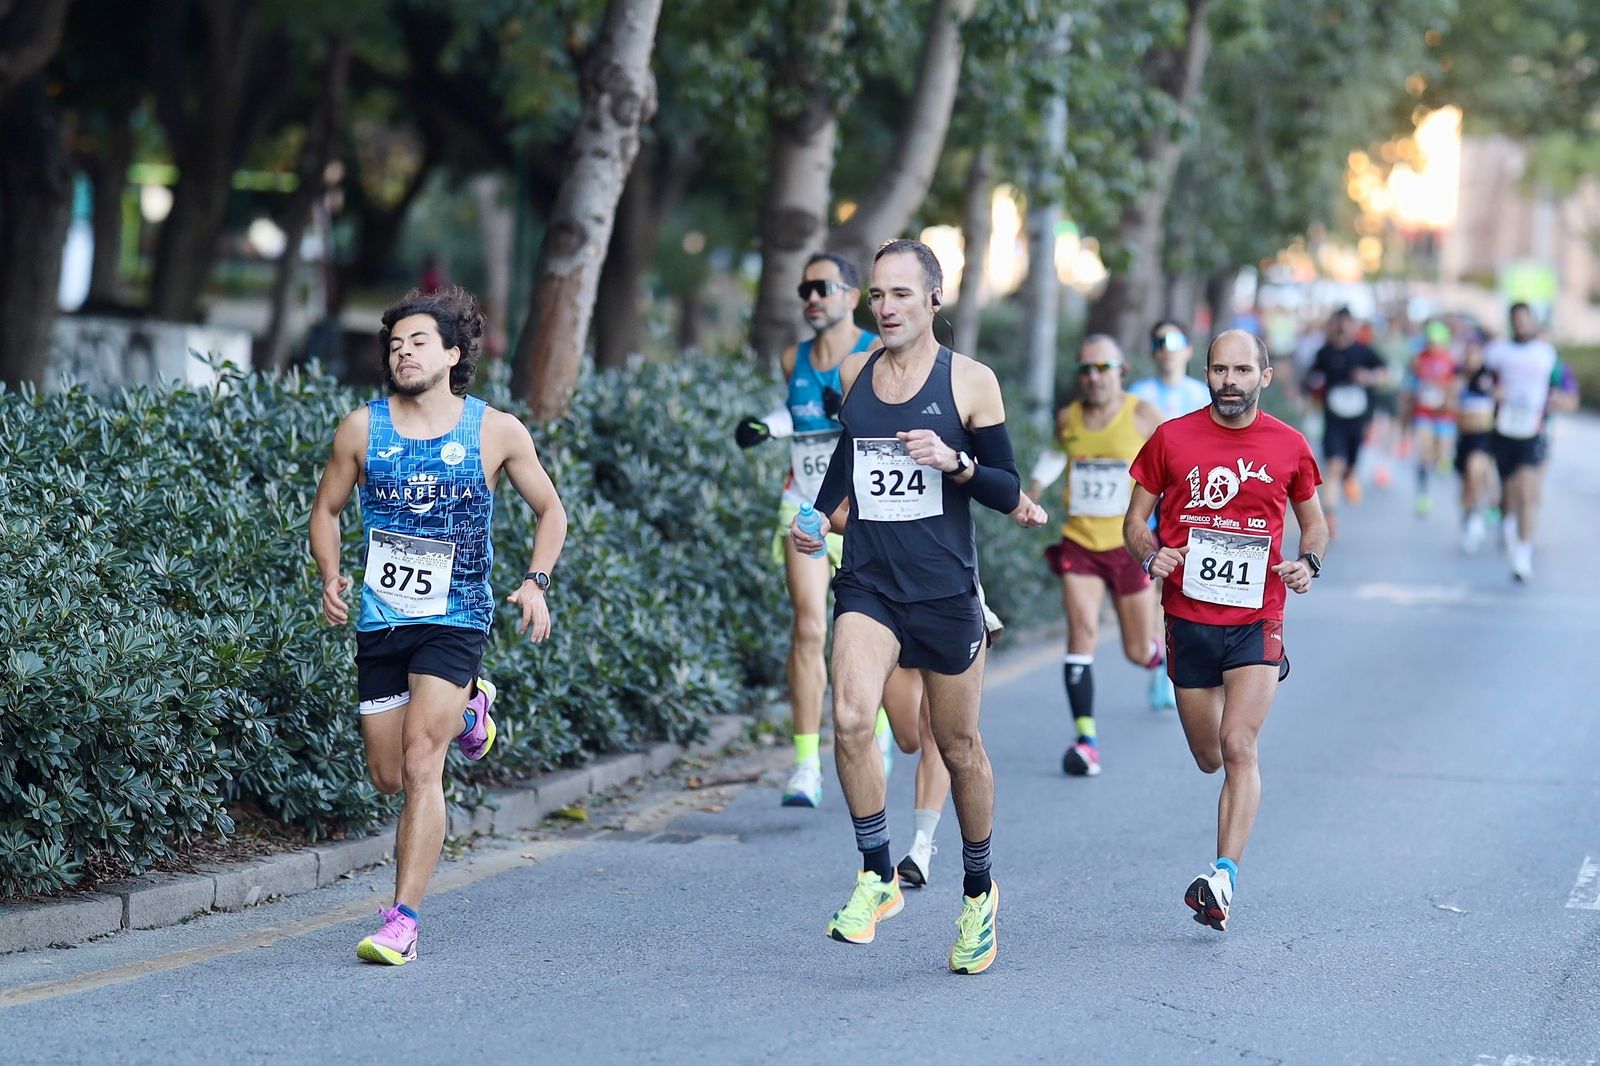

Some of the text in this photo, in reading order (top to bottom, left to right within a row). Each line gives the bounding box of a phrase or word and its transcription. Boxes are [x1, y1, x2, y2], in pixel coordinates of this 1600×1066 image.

[803, 454, 832, 476] 66
[375, 485, 473, 501] MARBELLA
[869, 469, 927, 497] 324
[1247, 516, 1267, 529] UCO
[380, 562, 432, 596] 875
[1199, 557, 1250, 585] 841
